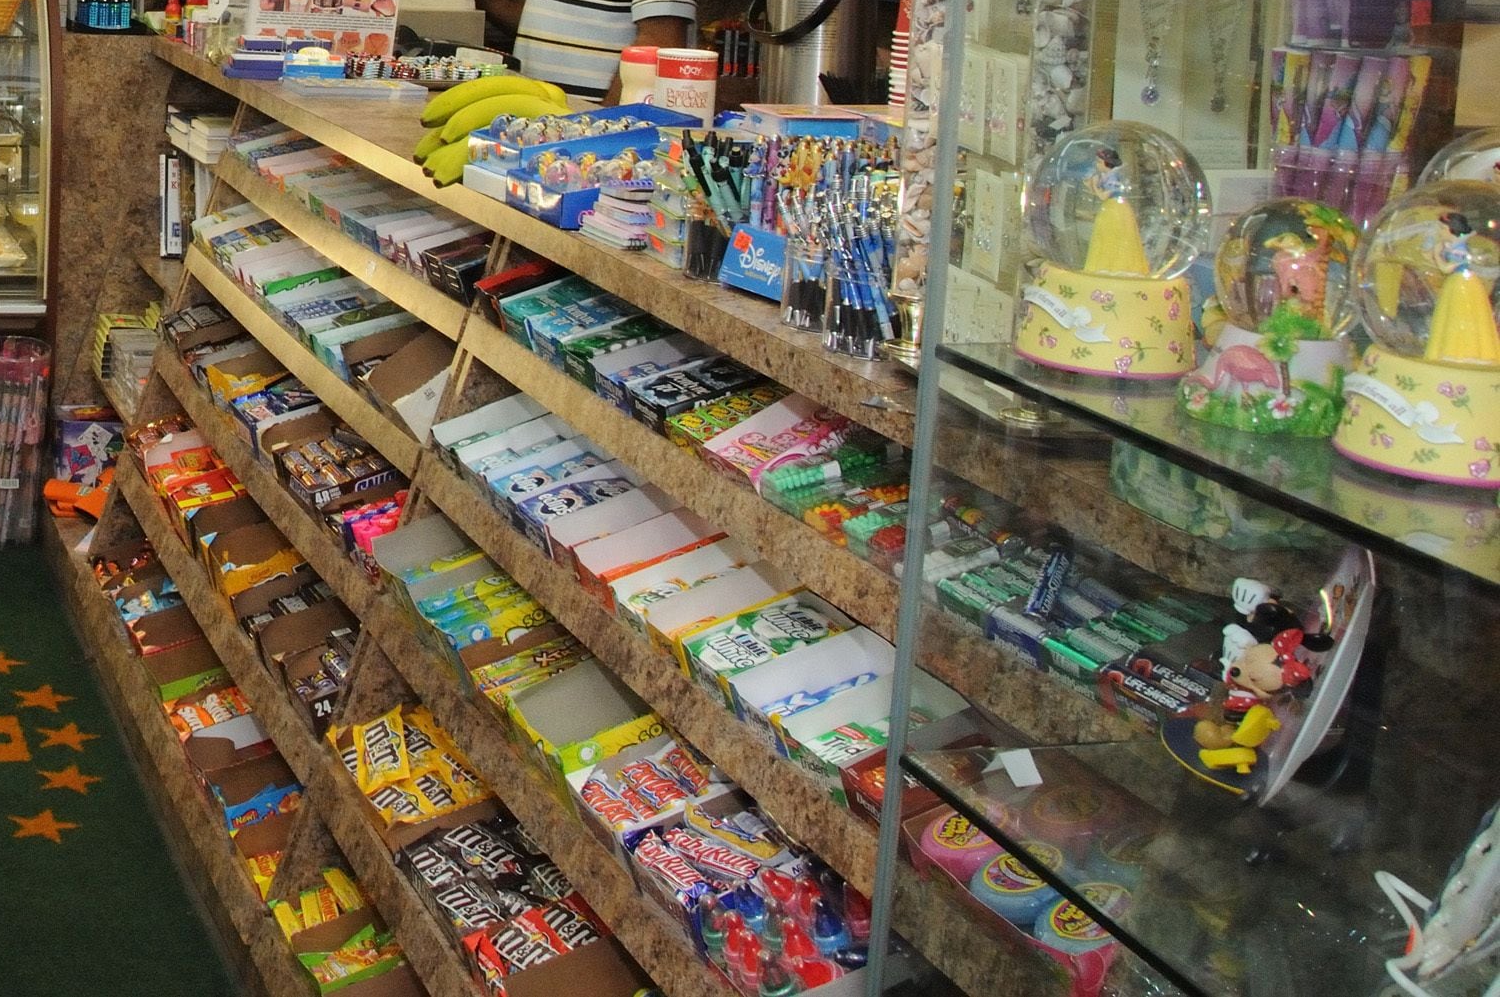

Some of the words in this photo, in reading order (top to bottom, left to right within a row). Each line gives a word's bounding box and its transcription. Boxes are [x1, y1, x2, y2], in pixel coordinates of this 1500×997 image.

[666, 97, 706, 109] SUGAR
[315, 699, 332, 718] 24
[822, 735, 868, 757] Trid
